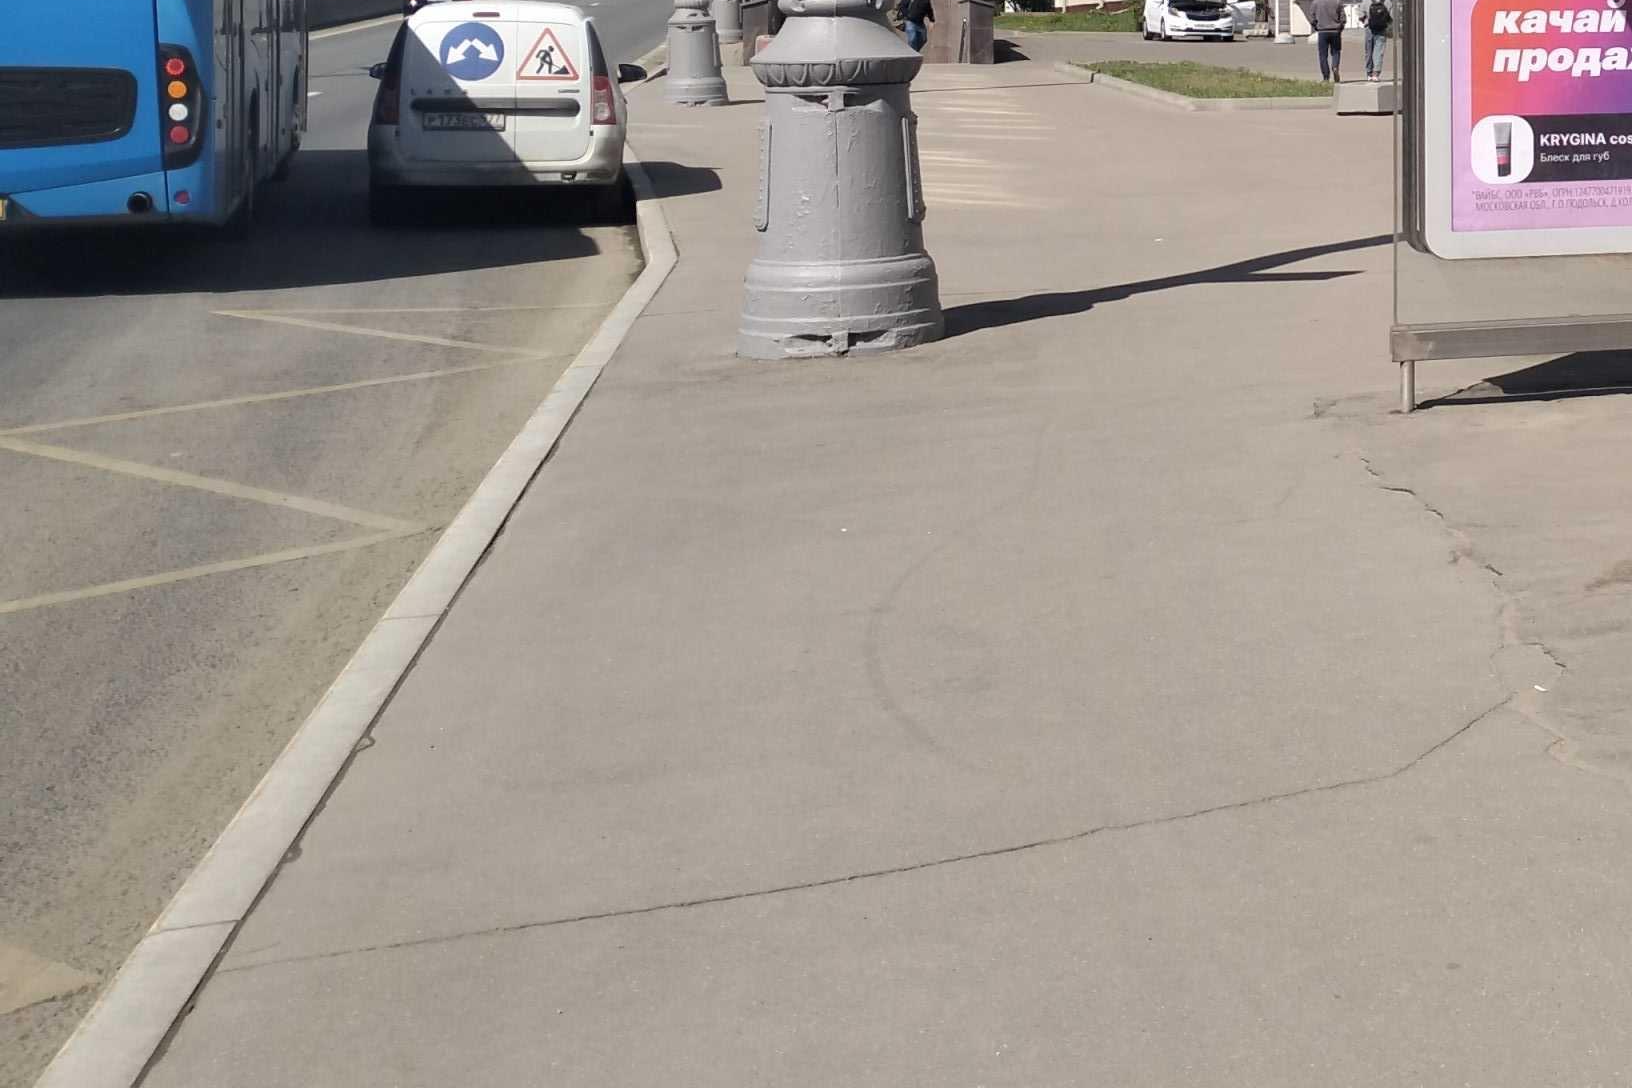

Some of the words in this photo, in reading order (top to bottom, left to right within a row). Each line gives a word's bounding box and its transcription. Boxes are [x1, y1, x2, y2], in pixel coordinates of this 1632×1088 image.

[1540, 132, 1606, 147] KRYGINA
[1540, 153, 1570, 163] Блеск
[1572, 154, 1591, 163] для
[1593, 152, 1610, 163] губ
